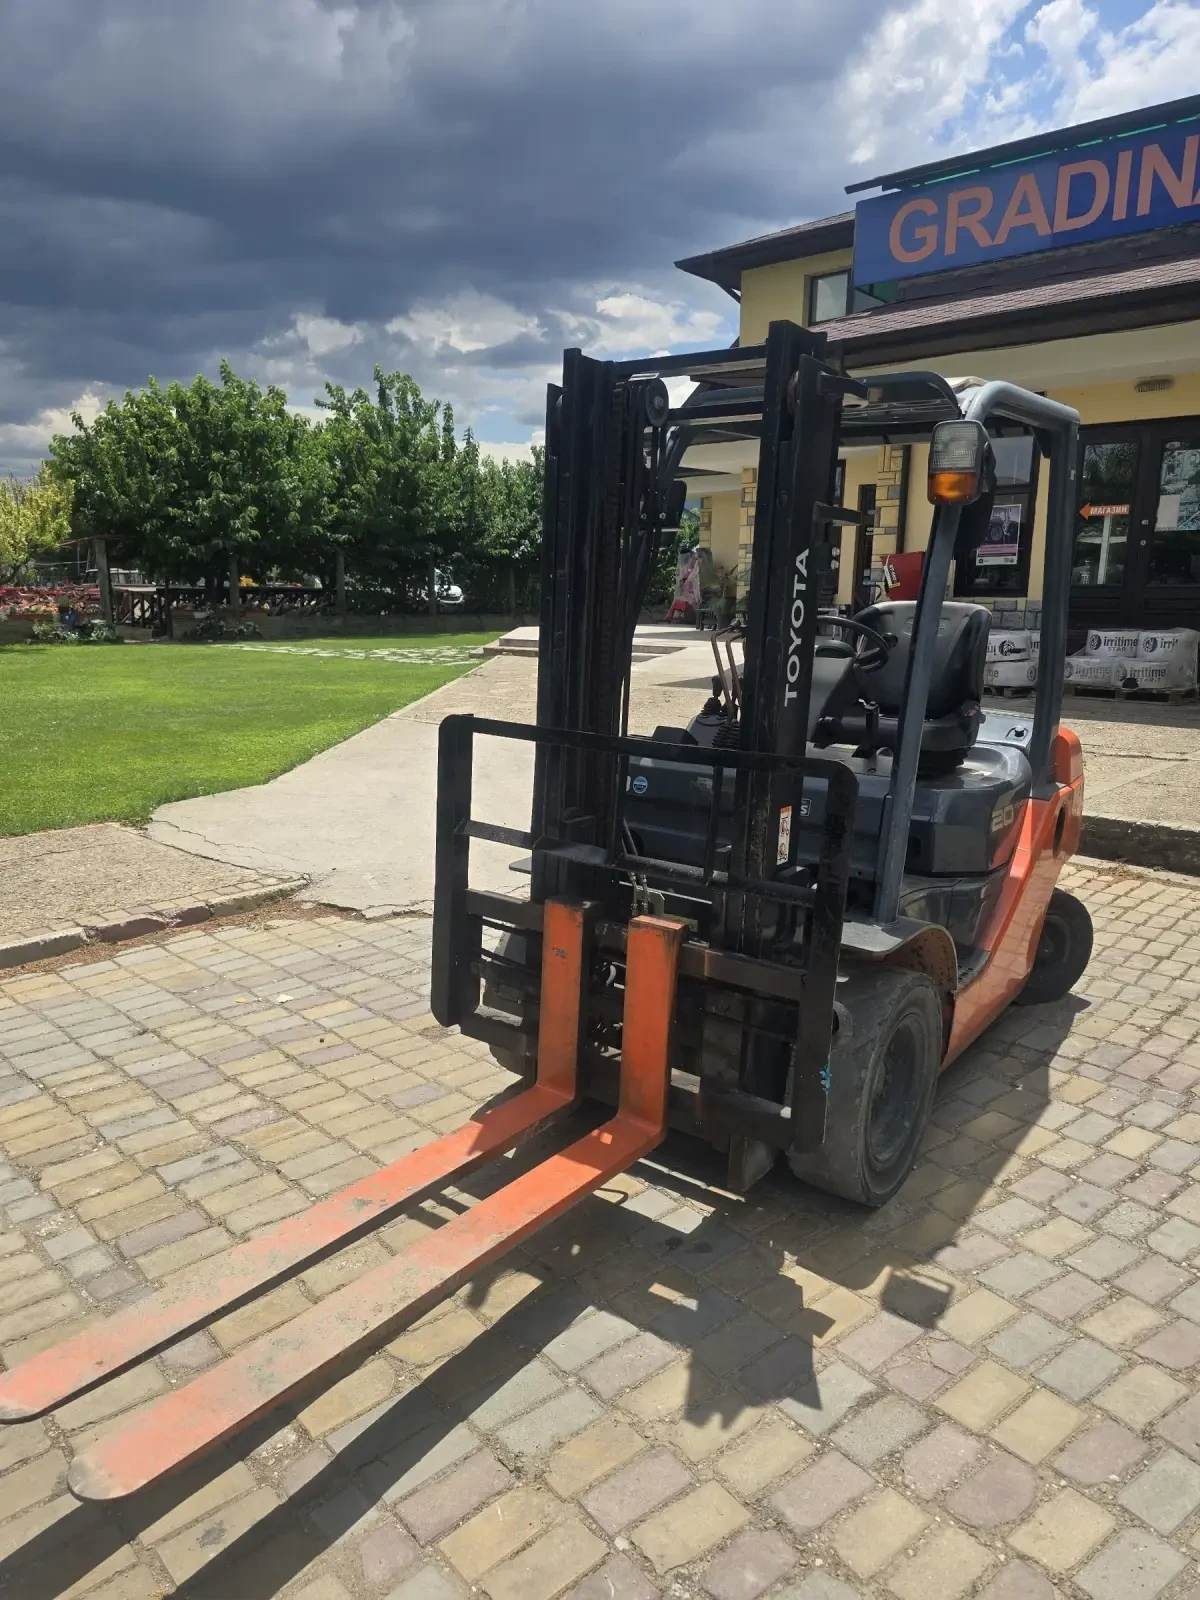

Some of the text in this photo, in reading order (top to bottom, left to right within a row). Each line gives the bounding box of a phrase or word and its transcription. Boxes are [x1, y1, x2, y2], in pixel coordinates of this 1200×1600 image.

[888, 134, 1200, 263] GRADIN
[1090, 506, 1128, 515] МАГАЗИН
[784, 548, 810, 707] TOYOTA
[1103, 636, 1138, 647] irritime
